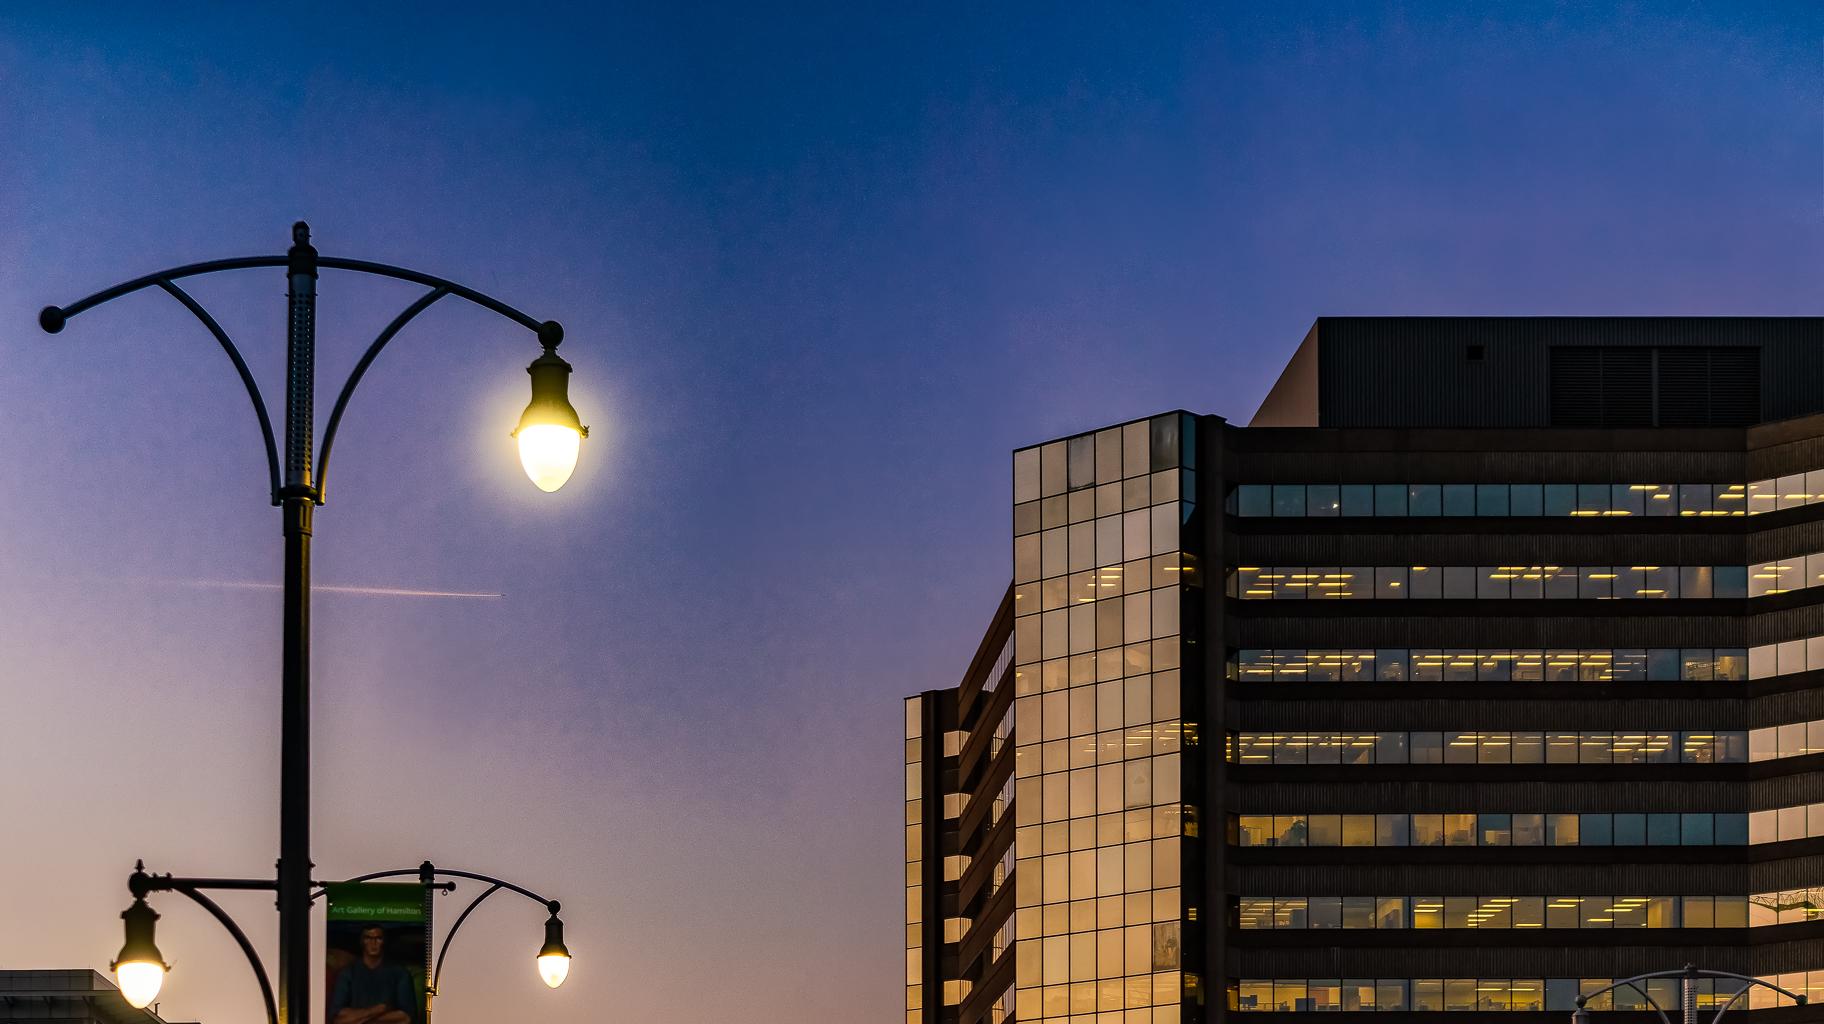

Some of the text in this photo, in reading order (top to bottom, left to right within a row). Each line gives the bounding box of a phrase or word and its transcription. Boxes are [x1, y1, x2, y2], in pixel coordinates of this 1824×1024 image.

[346, 906, 375, 916] Gallery
[377, 906, 385, 914] of
[386, 906, 421, 915] Hamilton
